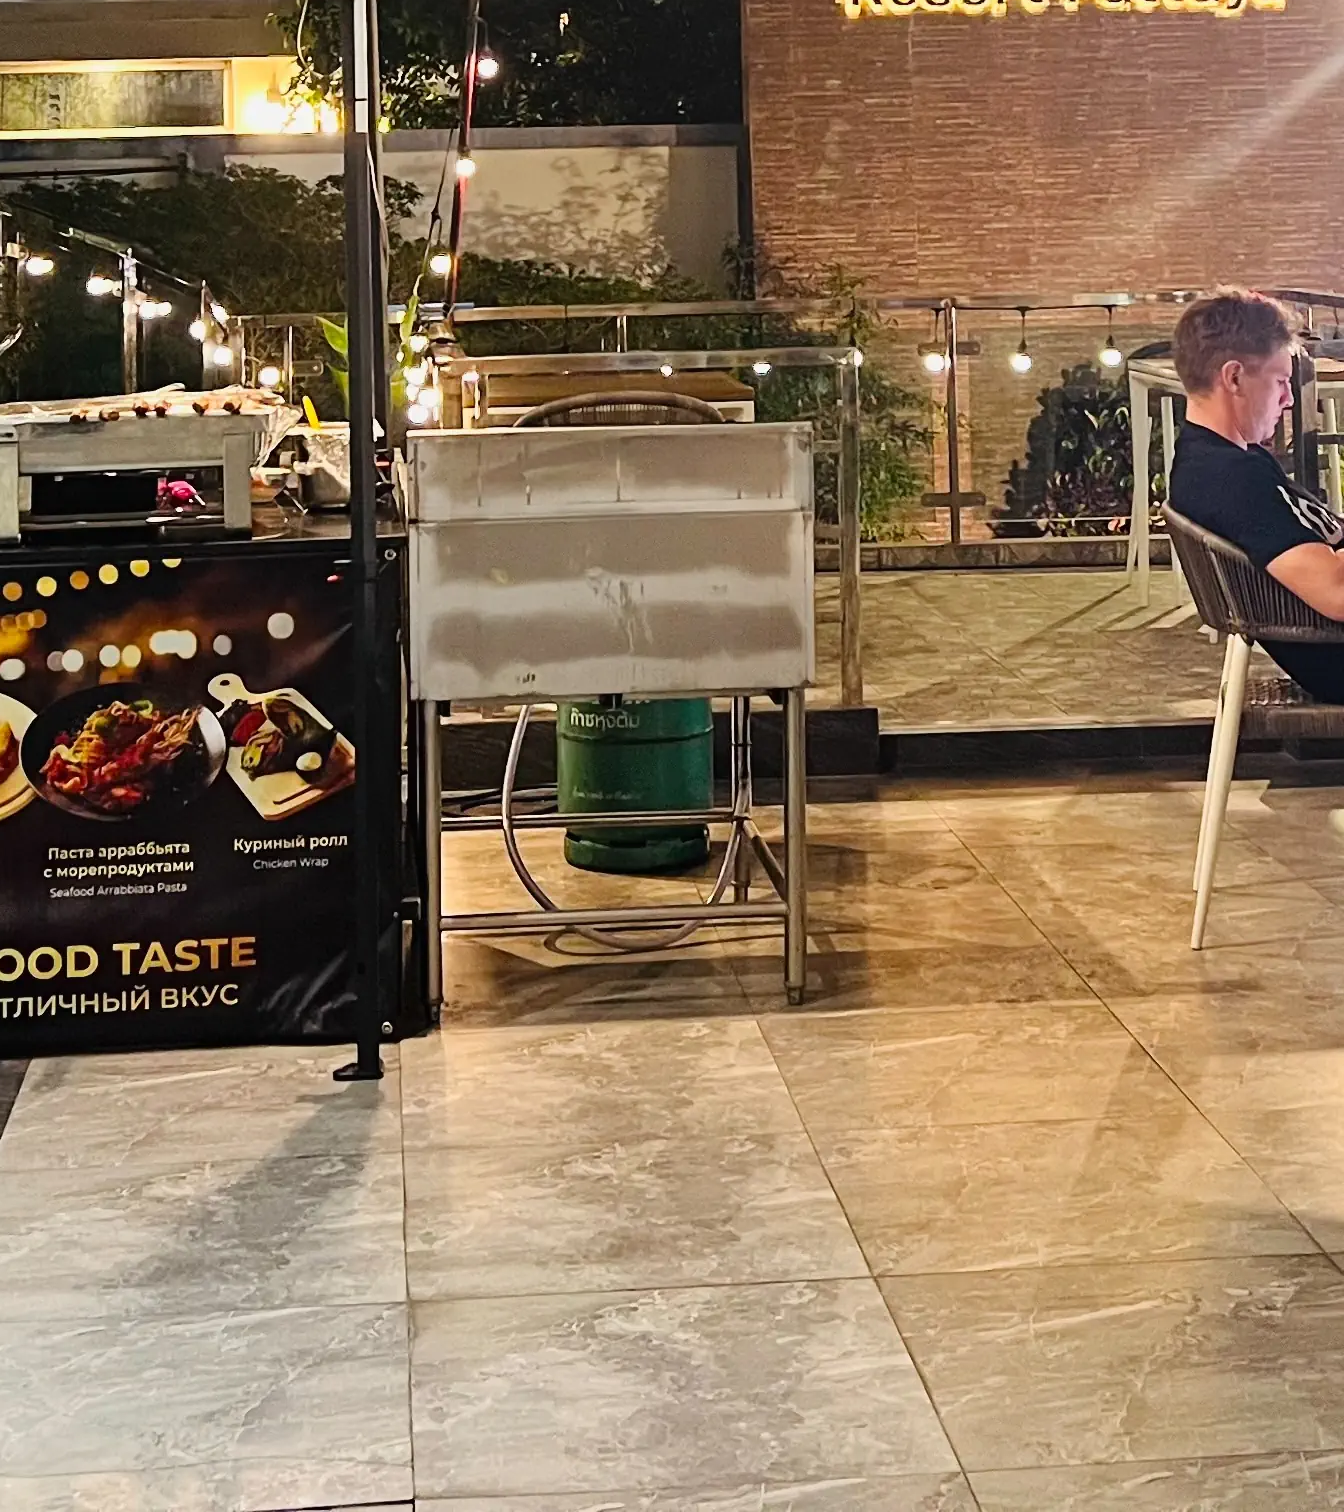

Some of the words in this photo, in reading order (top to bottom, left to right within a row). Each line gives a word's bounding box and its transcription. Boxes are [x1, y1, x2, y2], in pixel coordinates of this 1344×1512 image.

[48, 847, 94, 860] Паста
[98, 841, 190, 860] арраббьята
[233, 834, 306, 854] Куриный
[309, 835, 348, 850] ролл
[43, 868, 53, 878] с
[56, 861, 194, 879] морепродуктами
[252, 858, 297, 870] Chicken
[299, 857, 329, 867] Wrap
[49, 886, 95, 898] Seafood
[96, 884, 155, 895] Arrabbiata
[157, 882, 188, 893] Pasta
[112, 937, 257, 976] TASTE
[160, 983, 239, 1010] ВКУС
